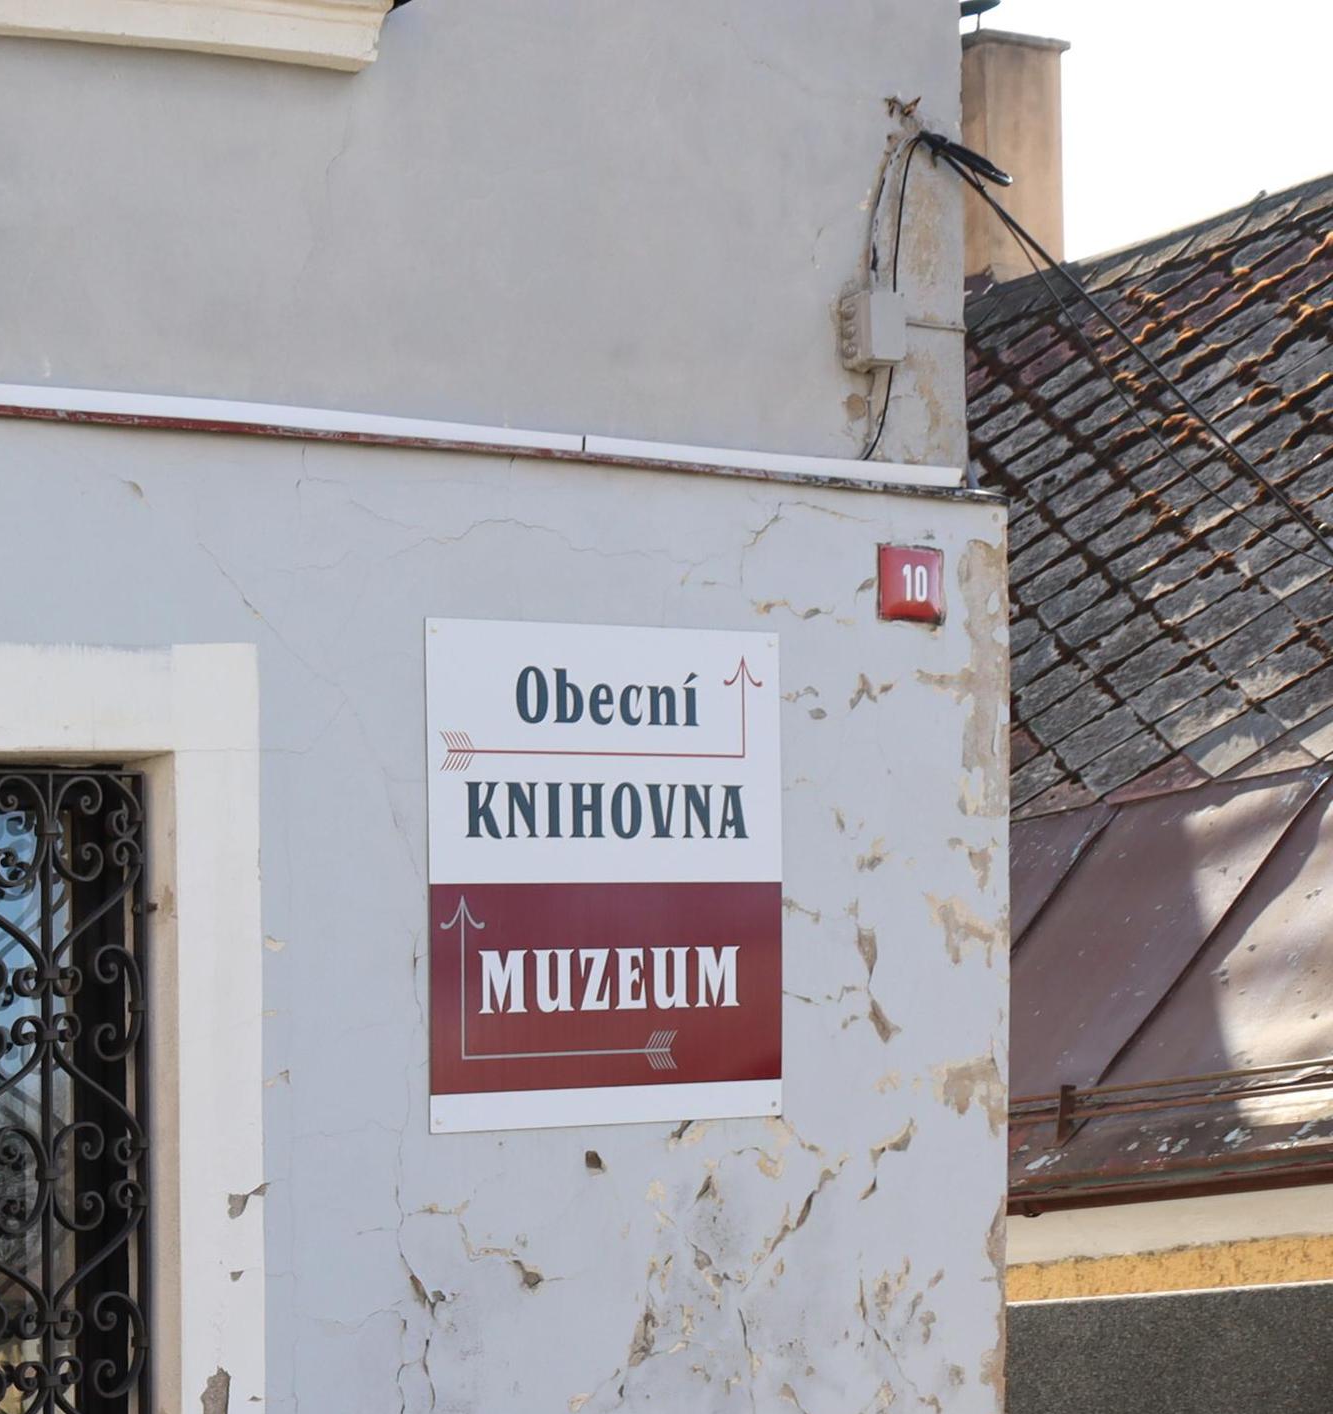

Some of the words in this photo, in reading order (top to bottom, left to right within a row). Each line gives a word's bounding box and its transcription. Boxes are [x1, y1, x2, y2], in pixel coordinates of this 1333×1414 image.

[902, 564, 928, 603] 10
[515, 666, 700, 727] Obecní
[464, 780, 750, 840] KNIHOVNA
[478, 945, 741, 1015] MUZEUM
